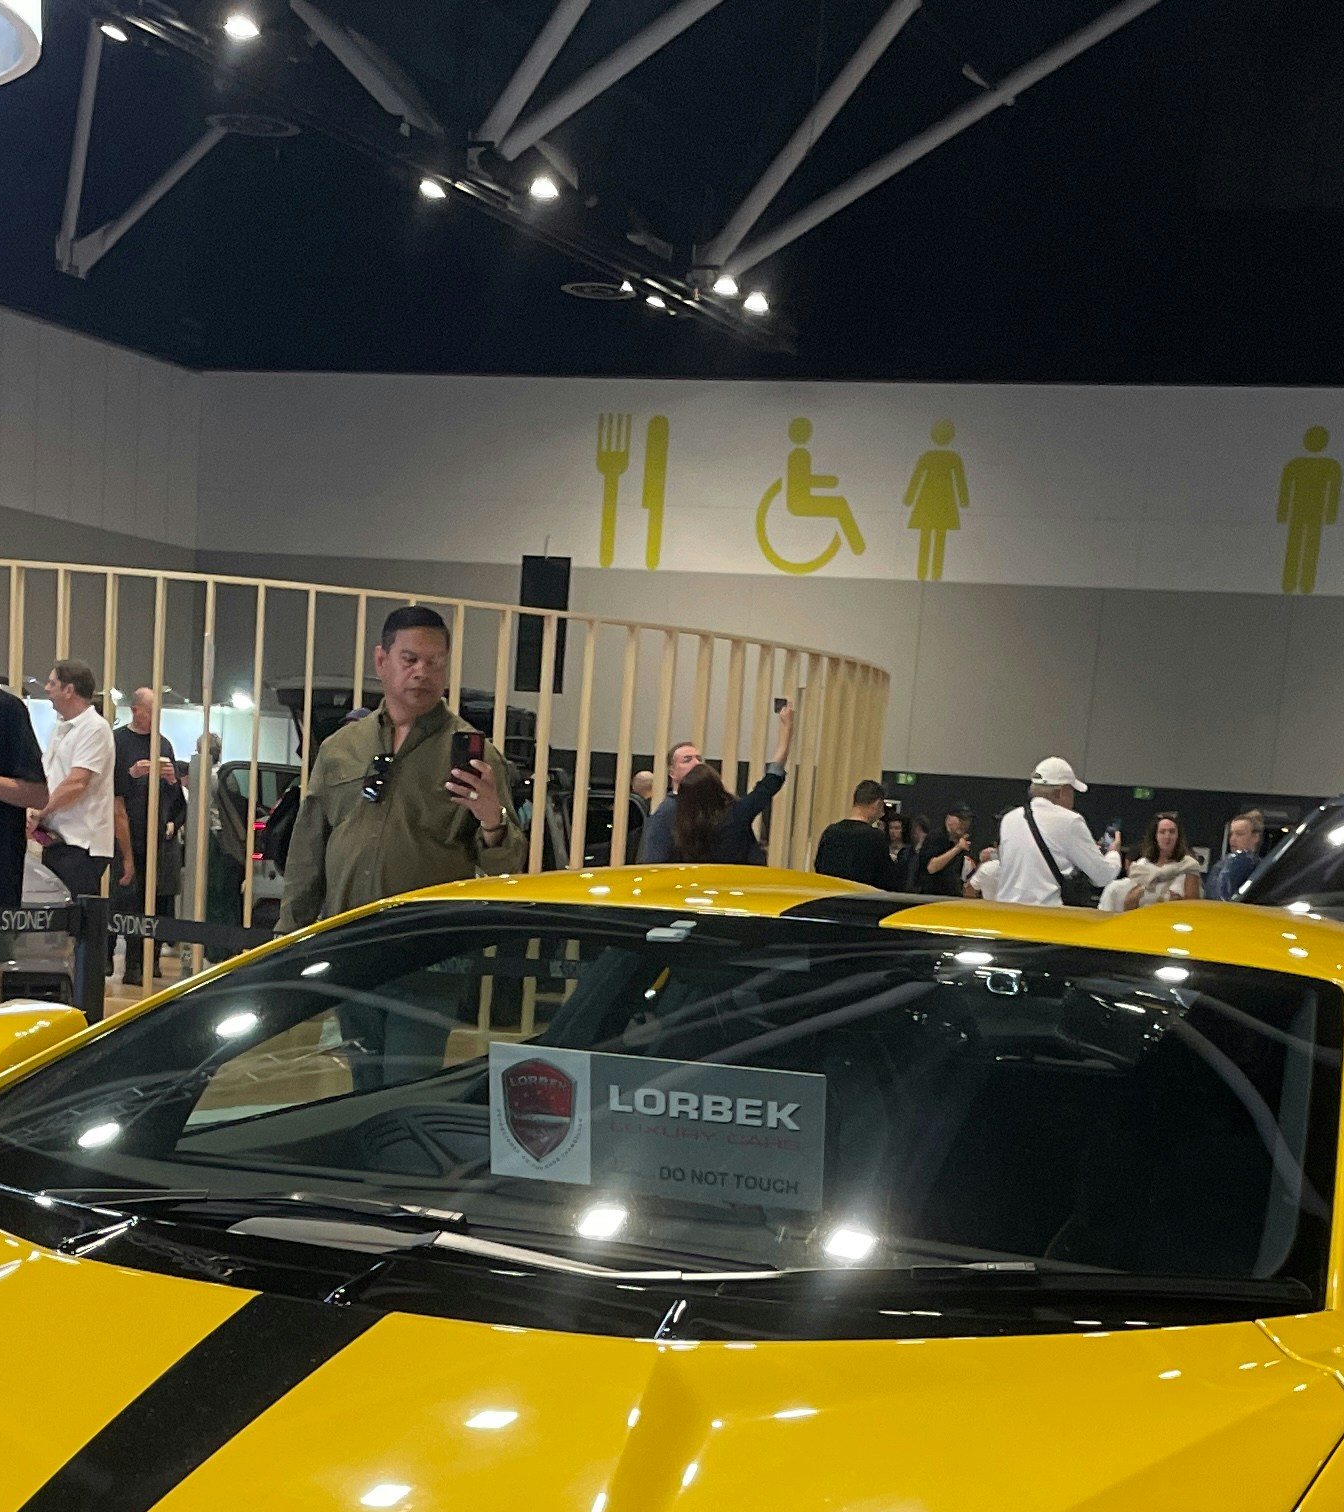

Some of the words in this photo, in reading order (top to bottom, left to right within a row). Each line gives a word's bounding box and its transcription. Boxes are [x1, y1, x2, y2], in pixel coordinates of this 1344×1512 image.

[1, 910, 54, 930] SYDNEY
[112, 913, 159, 937] SYDNEY
[609, 1084, 801, 1131] LORBEK
[659, 1166, 686, 1182] DO
[691, 1169, 728, 1187] NOT
[733, 1173, 800, 1195] TOUCH
